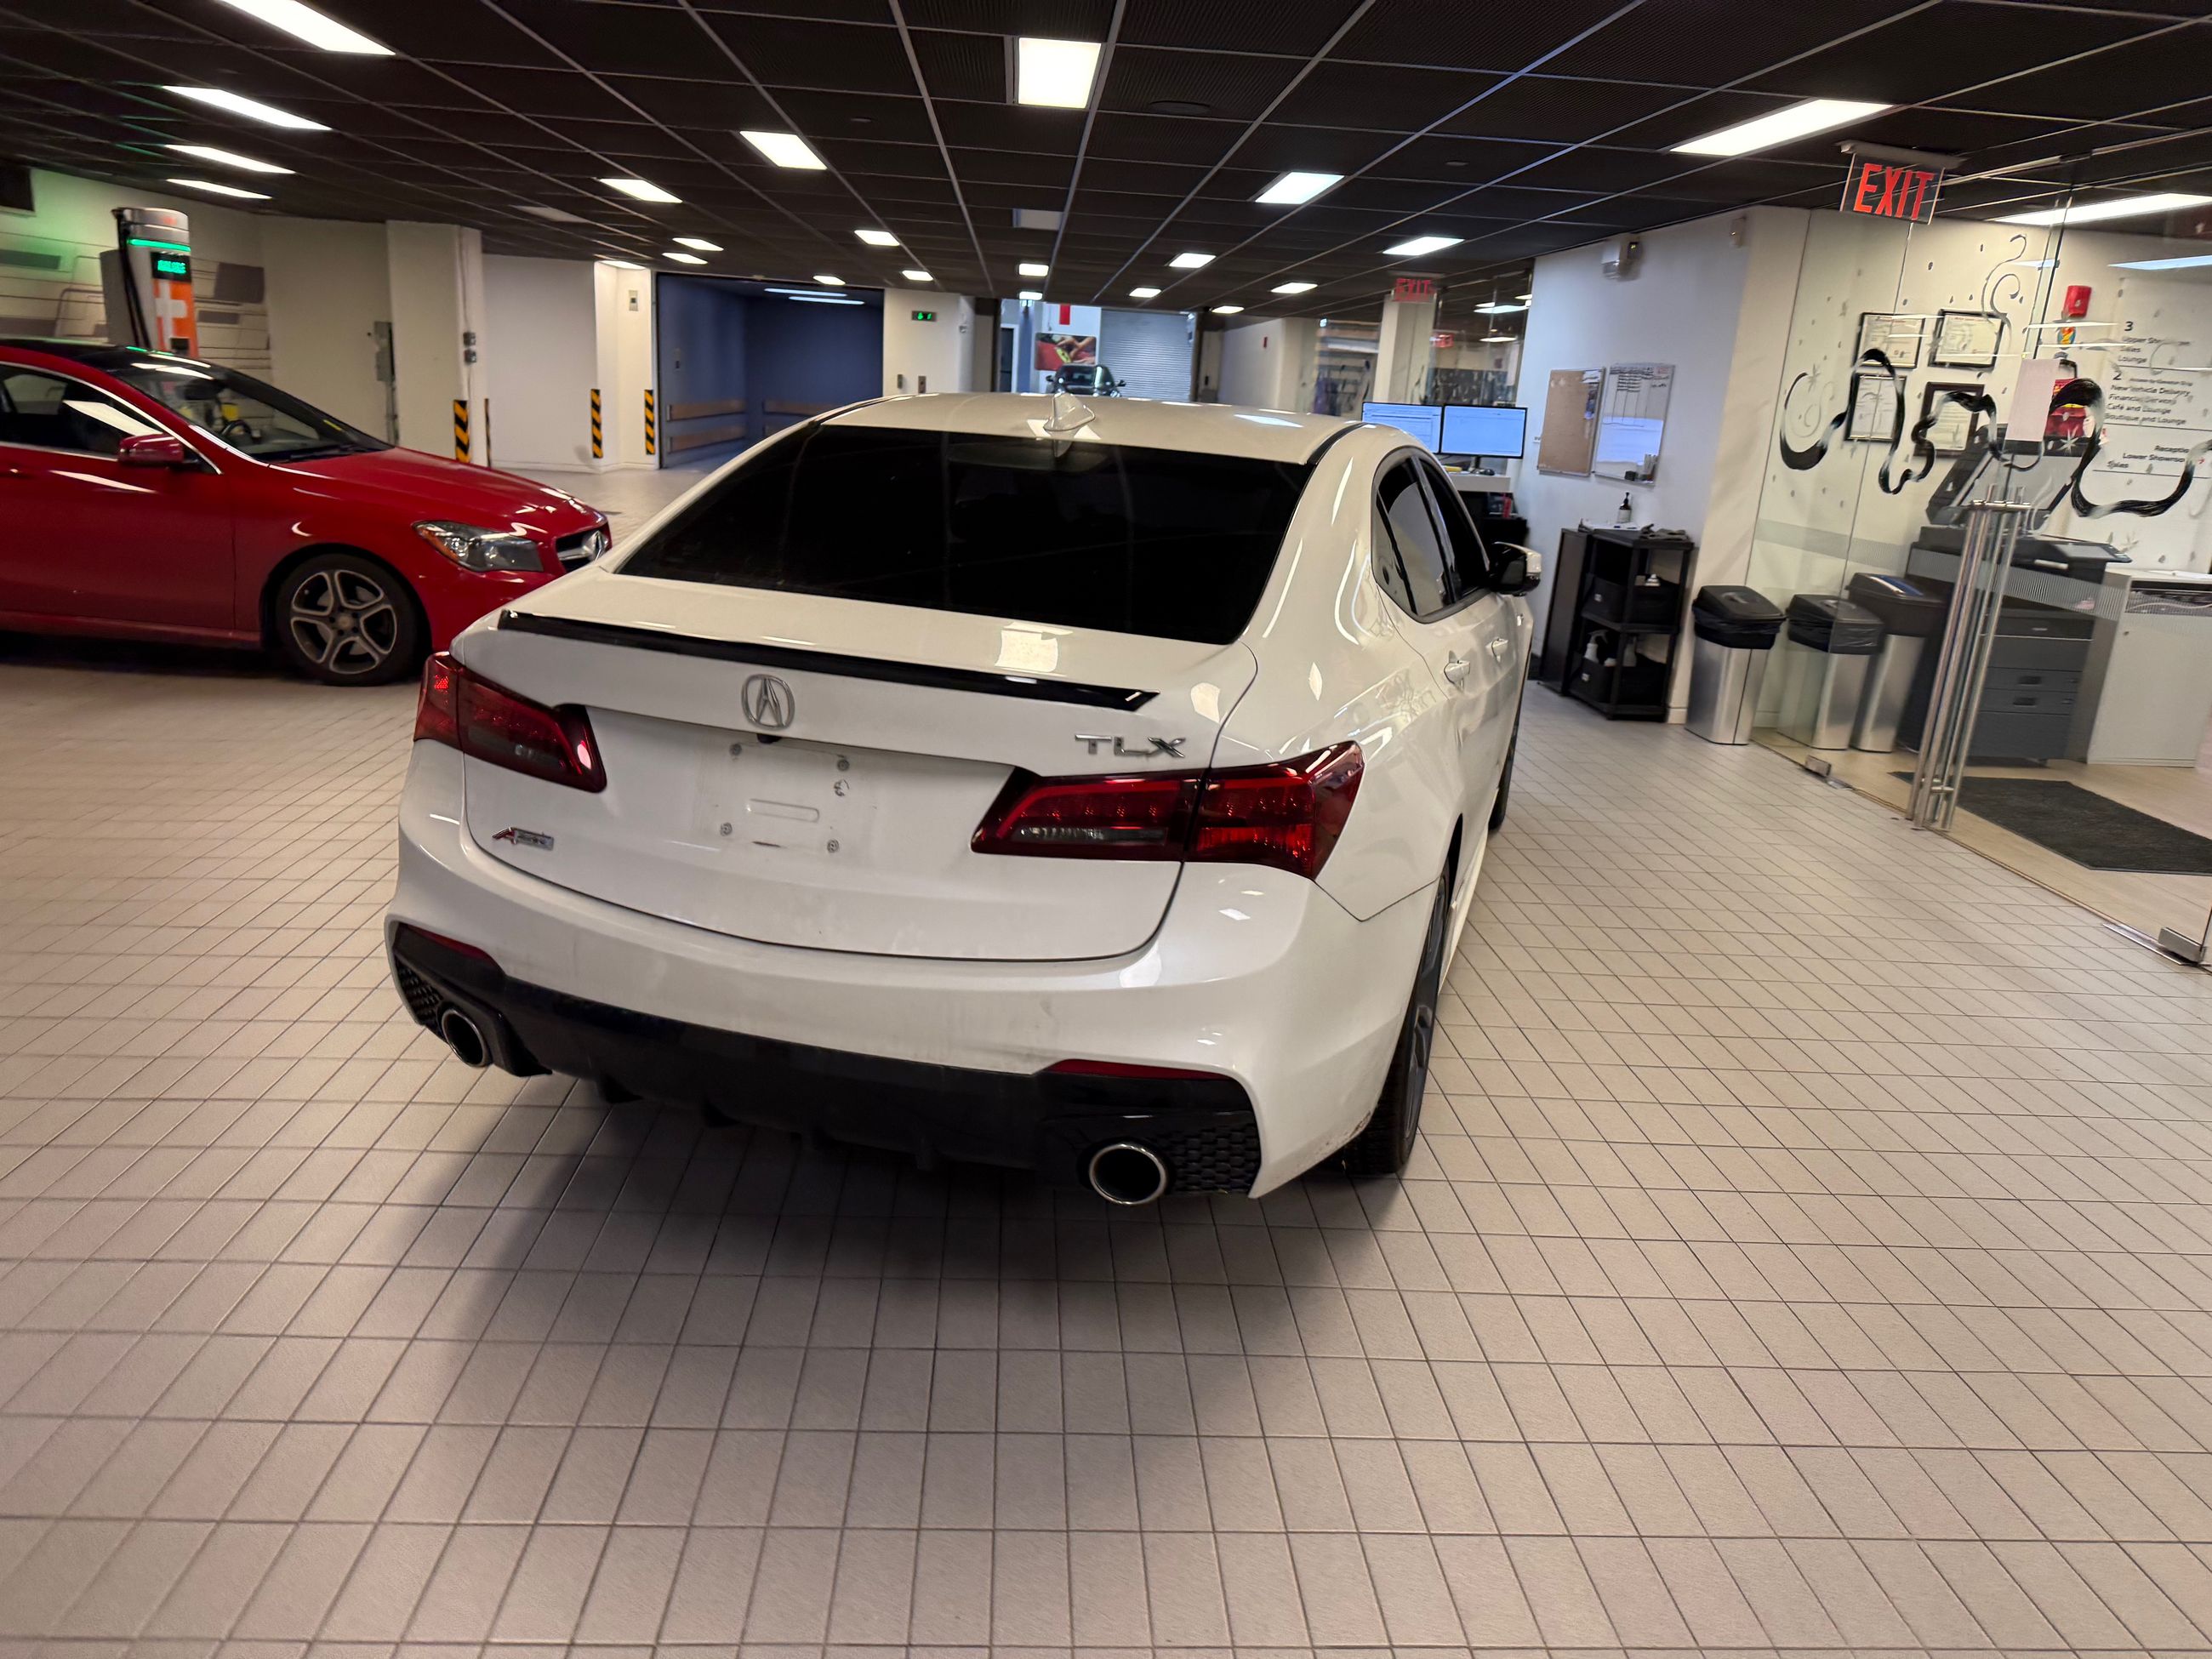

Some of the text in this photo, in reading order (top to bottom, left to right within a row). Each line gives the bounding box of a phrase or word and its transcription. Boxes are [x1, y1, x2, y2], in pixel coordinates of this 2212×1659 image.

[1854, 163, 1935, 220] EXIT
[1394, 277, 1432, 299] EXIT
[2124, 321, 2134, 331] 3
[2118, 356, 2146, 364] Lounge
[2158, 415, 2186, 425] Lounge
[2154, 445, 2190, 453] Receptio
[2149, 453, 2185, 463] Showroo
[1075, 733, 1186, 757] TLX
